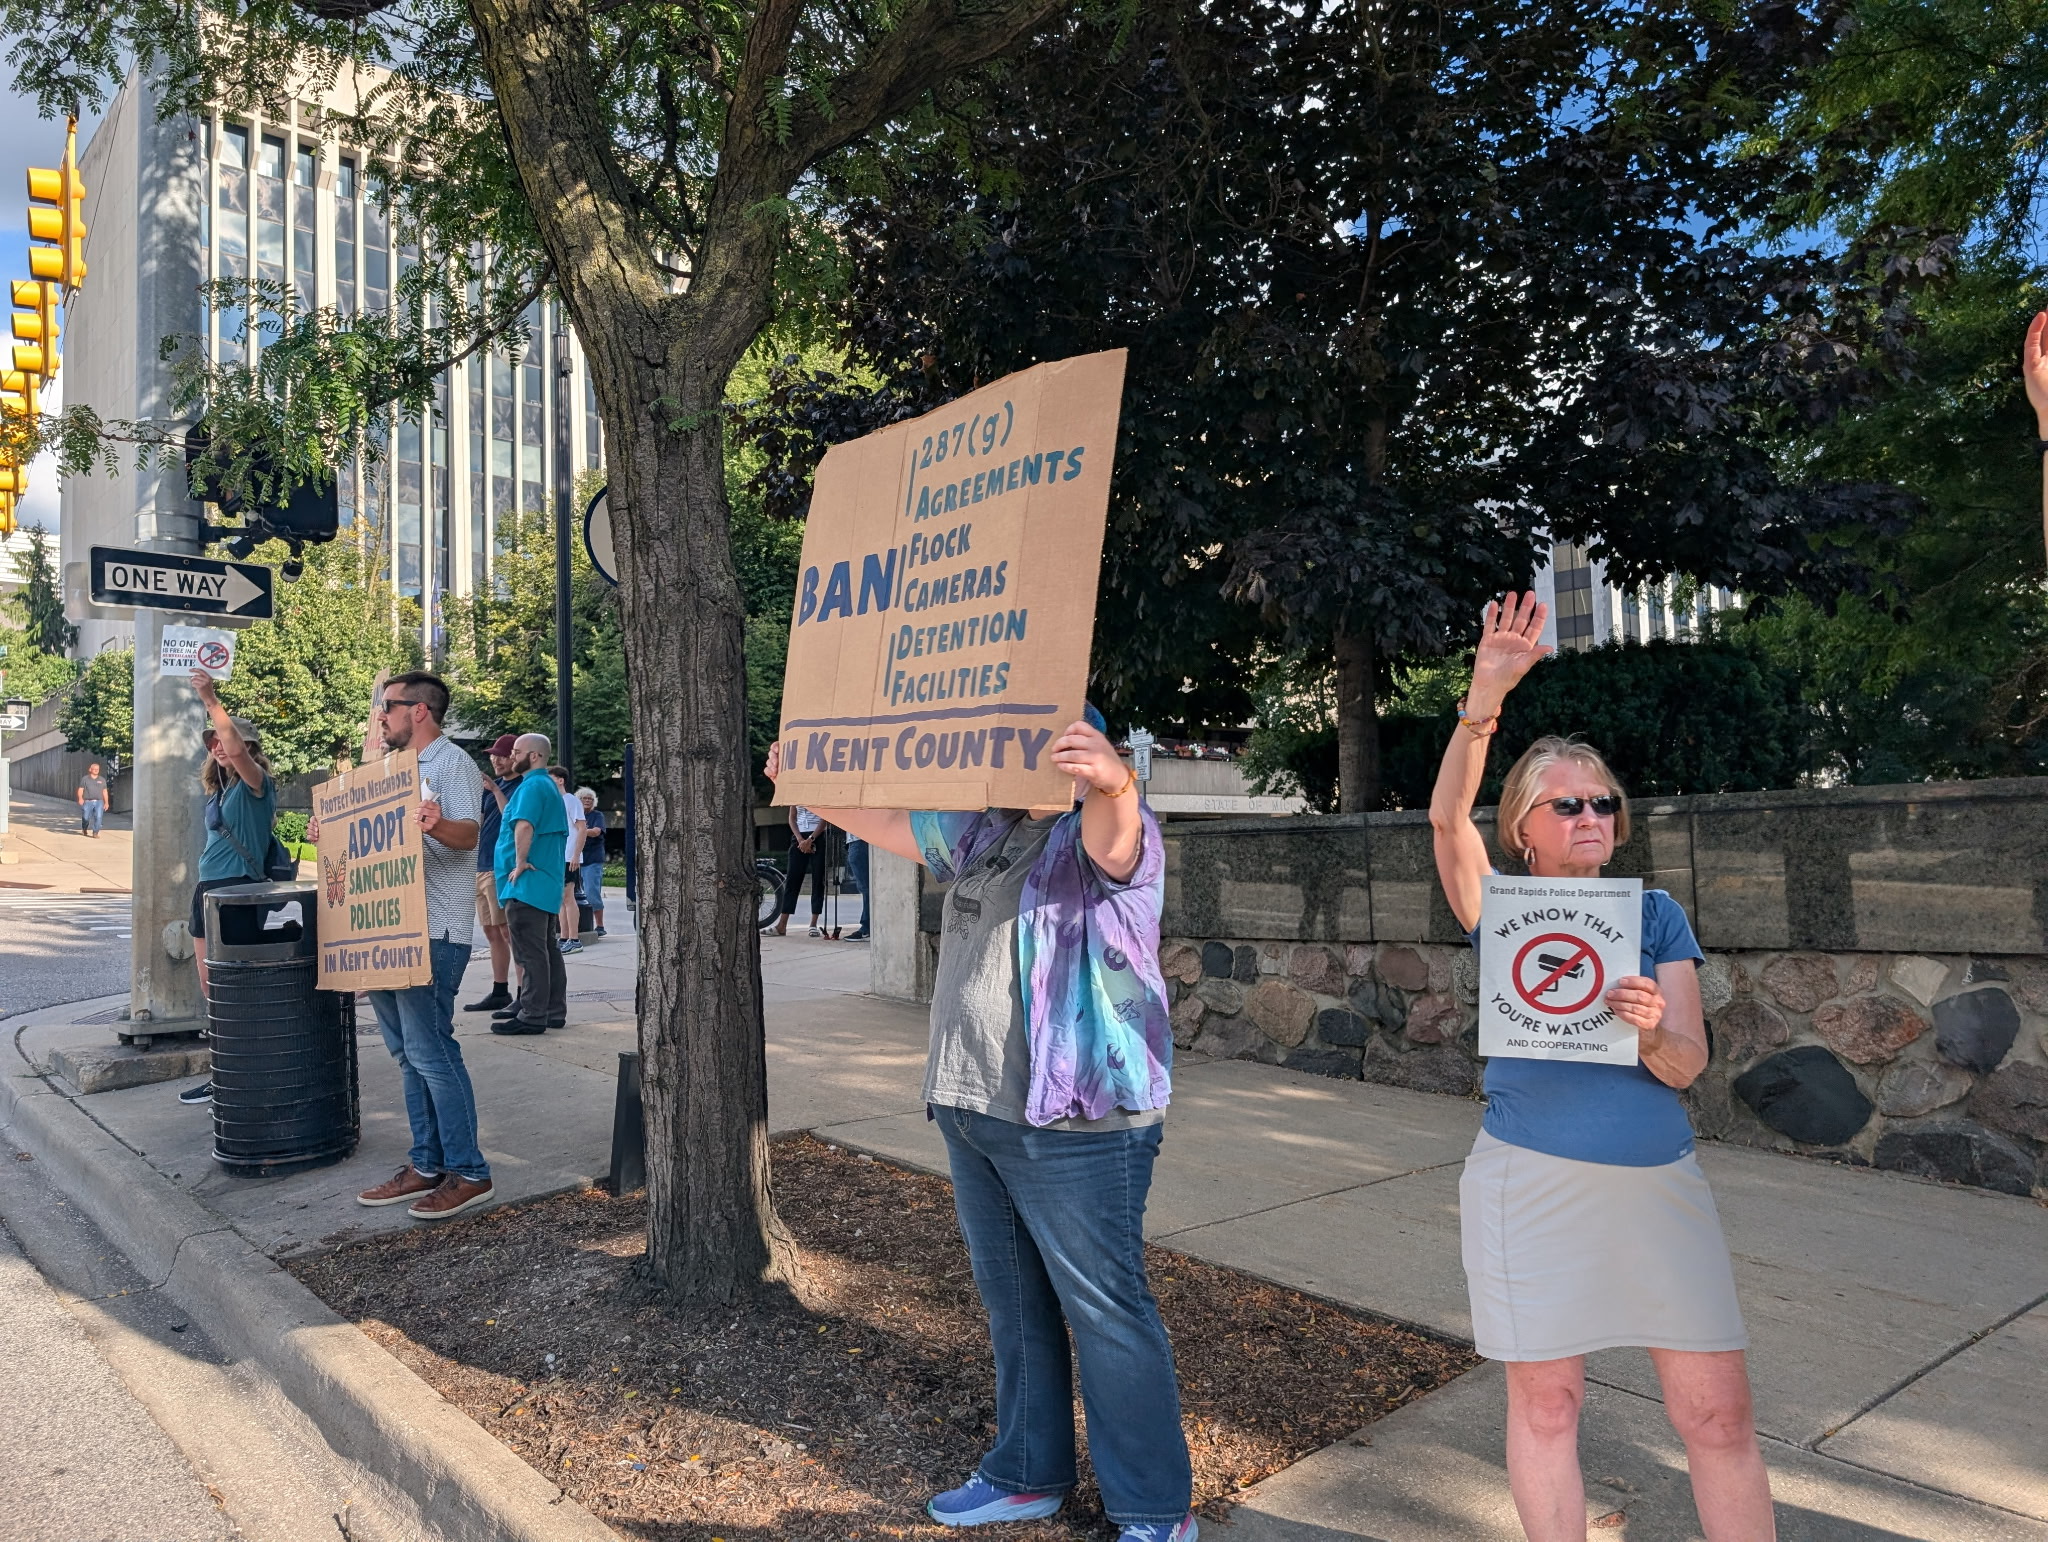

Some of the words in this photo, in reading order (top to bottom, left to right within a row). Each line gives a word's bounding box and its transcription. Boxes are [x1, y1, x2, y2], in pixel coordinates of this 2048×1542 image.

[920, 400, 1015, 470] 287(g)
[914, 446, 1085, 523] AGREEMENTS
[908, 523, 972, 569] FLOCK
[112, 566, 167, 592] ONE
[176, 572, 227, 598] WAY
[797, 548, 898, 627] BAN
[904, 560, 1008, 613] CAMERAS
[163, 639, 177, 648] NO
[179, 640, 199, 648] ONE
[896, 608, 1028, 661] DETENTION
[162, 659, 196, 667] STATE
[890, 661, 1011, 707] FACILITIES
[781, 739, 799, 773] IN
[806, 731, 890, 773] KENT
[894, 725, 1054, 772] COUNTY
[320, 793, 350, 816] PROTECT
[350, 786, 367, 805] OUR
[368, 769, 413, 799] NEIGHBORS
[1204, 799, 1238, 811] STATE
[1248, 799, 1261, 811] OF
[348, 805, 406, 860] ADOPT
[349, 854, 418, 896] SANCTUARY
[1489, 886, 1516, 896] Grand
[1518, 887, 1548, 897] Rapids
[1549, 888, 1577, 897] Police
[1578, 889, 1631, 898] Department
[350, 897, 401, 932] POLICIES
[1494, 919, 1521, 939] WE
[1521, 908, 1579, 926] KNOW
[1584, 913, 1625, 944] THAT
[324, 953, 337, 973] IN
[339, 948, 370, 973] KENT
[372, 944, 424, 970] COUNTY
[1491, 992, 1542, 1033] YOU'RE
[1545, 1006, 1616, 1036] WATCHIN
[1506, 1038, 1529, 1048] AND
[1531, 1040, 1609, 1052] COOPERATING
